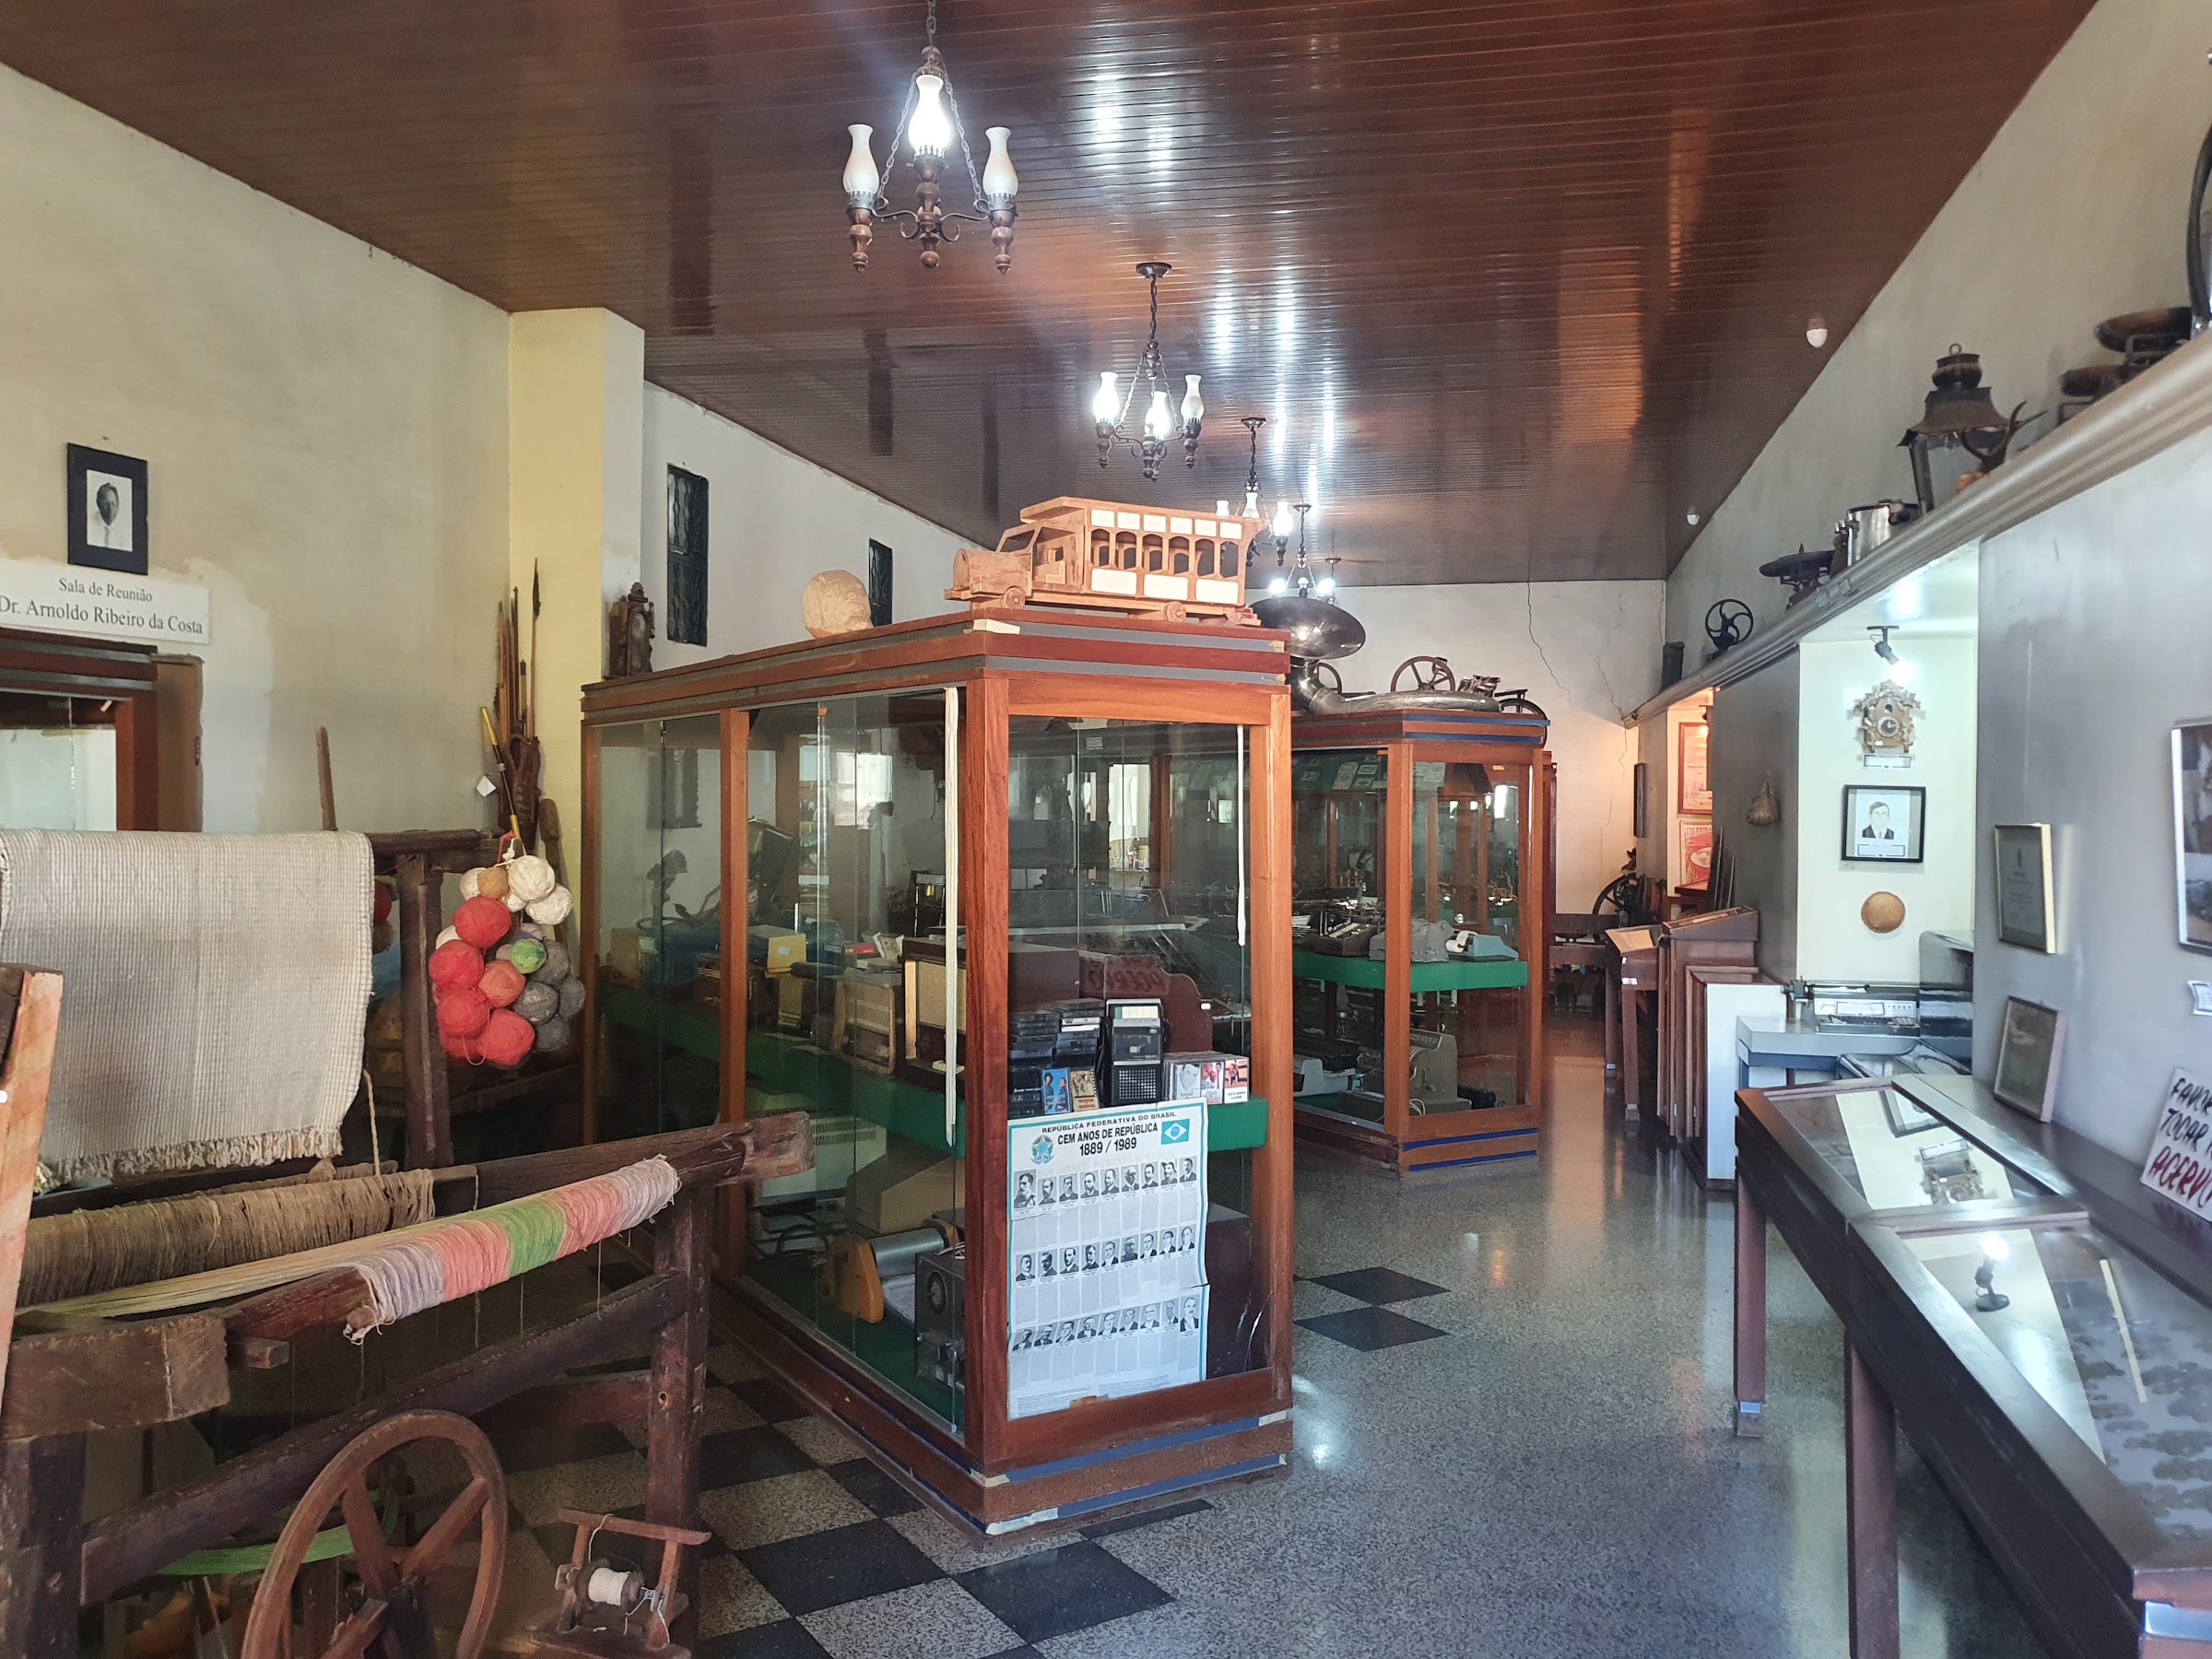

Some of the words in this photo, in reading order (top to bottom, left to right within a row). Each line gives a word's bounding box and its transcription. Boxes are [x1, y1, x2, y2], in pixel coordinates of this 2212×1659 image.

[58, 577, 85, 594] Sala
[88, 581, 103, 596] de
[106, 583, 153, 602] Reunião
[0, 594, 21, 615] Dr.
[26, 599, 88, 622] Arnoldo
[93, 606, 145, 628] Ribeiro
[148, 613, 164, 629] da
[168, 616, 203, 635] Costa
[1041, 1123, 1084, 1134] REPÚBLICA
[1086, 1116, 1136, 1128] FEDERATIVA
[1150, 1112, 1176, 1120] BRASIL
[1057, 1134, 1076, 1145] CEM
[1077, 1130, 1100, 1143] ANOS
[1102, 1128, 1113, 1139] DE
[1114, 1123, 1159, 1137] REPÚBLICA
[2159, 1108, 2210, 1152] TOCAR
[1079, 1141, 1103, 1157] 1889
[1114, 1136, 1137, 1152] 1989
